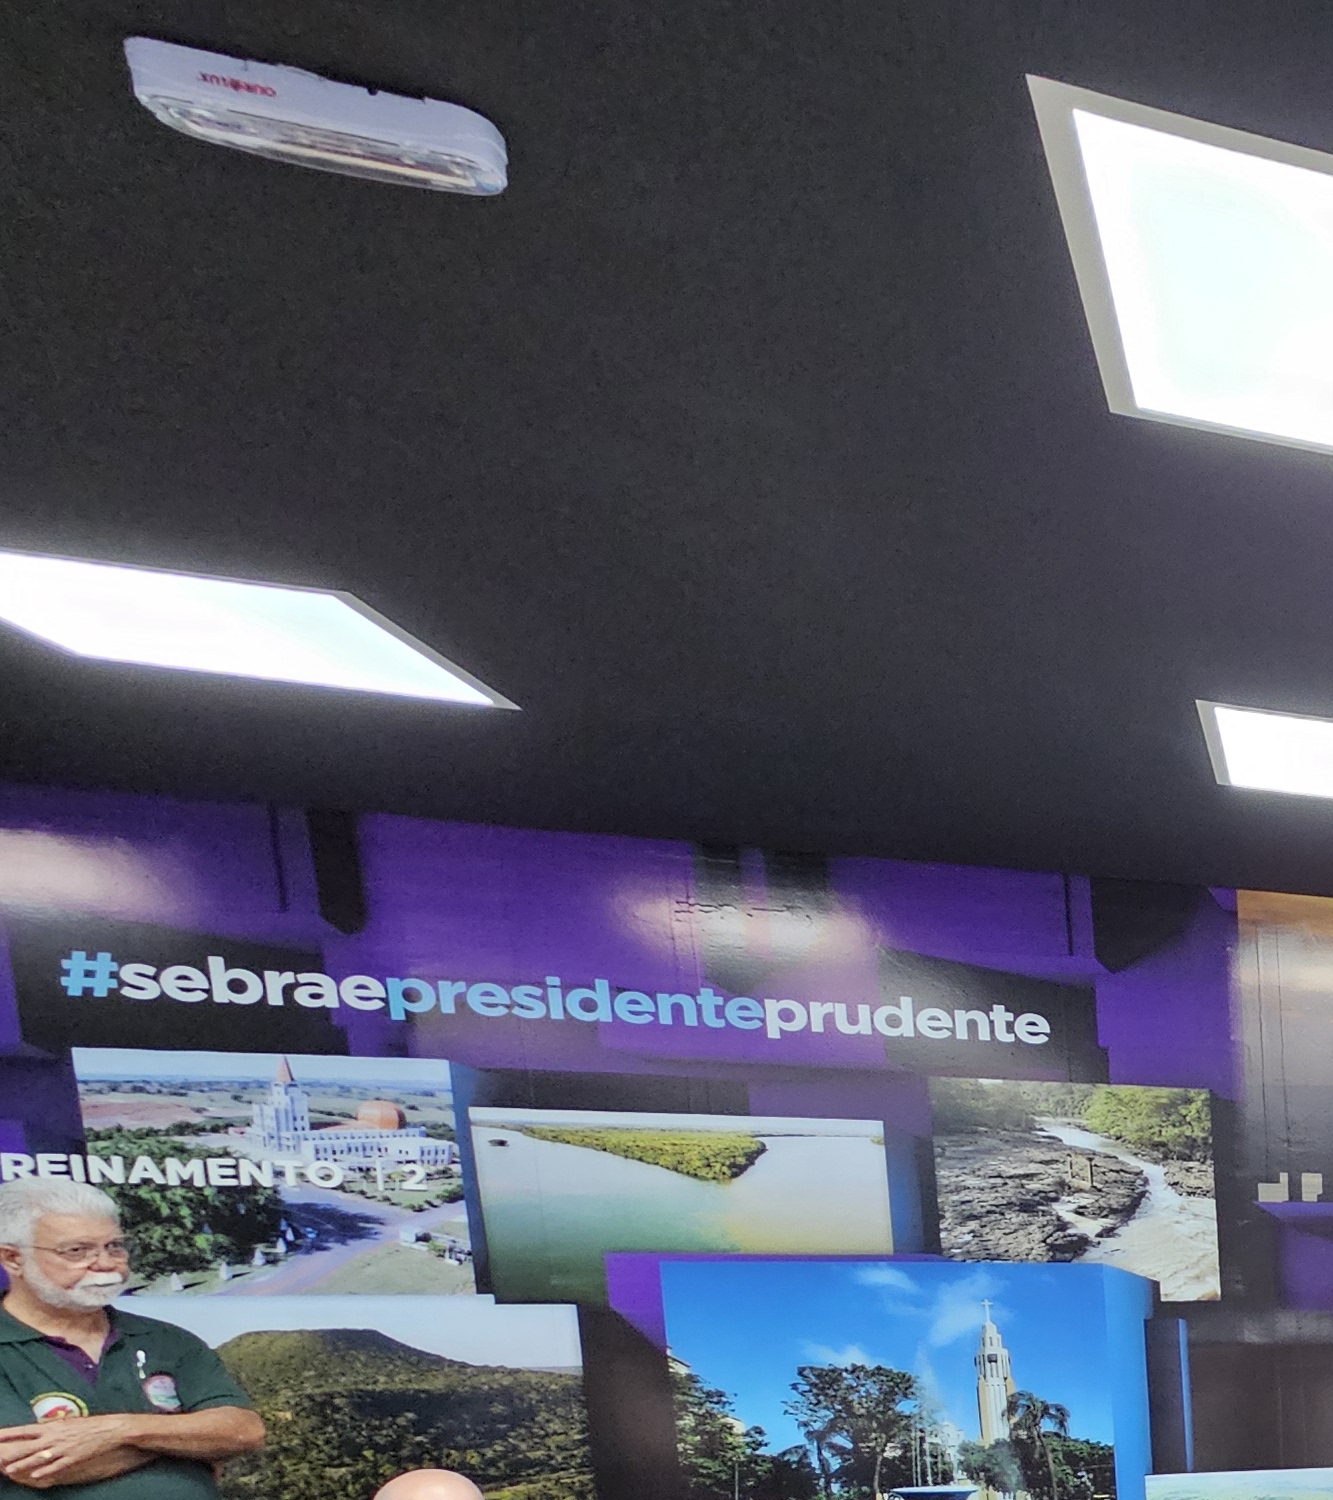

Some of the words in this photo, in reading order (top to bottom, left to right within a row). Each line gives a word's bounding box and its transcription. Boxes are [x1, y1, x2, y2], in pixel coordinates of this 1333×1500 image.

[60, 950, 1051, 1045] #sebraepresidenteprudente
[0, 1152, 345, 1189] REINAMENTO
[401, 1162, 429, 1190] 2
